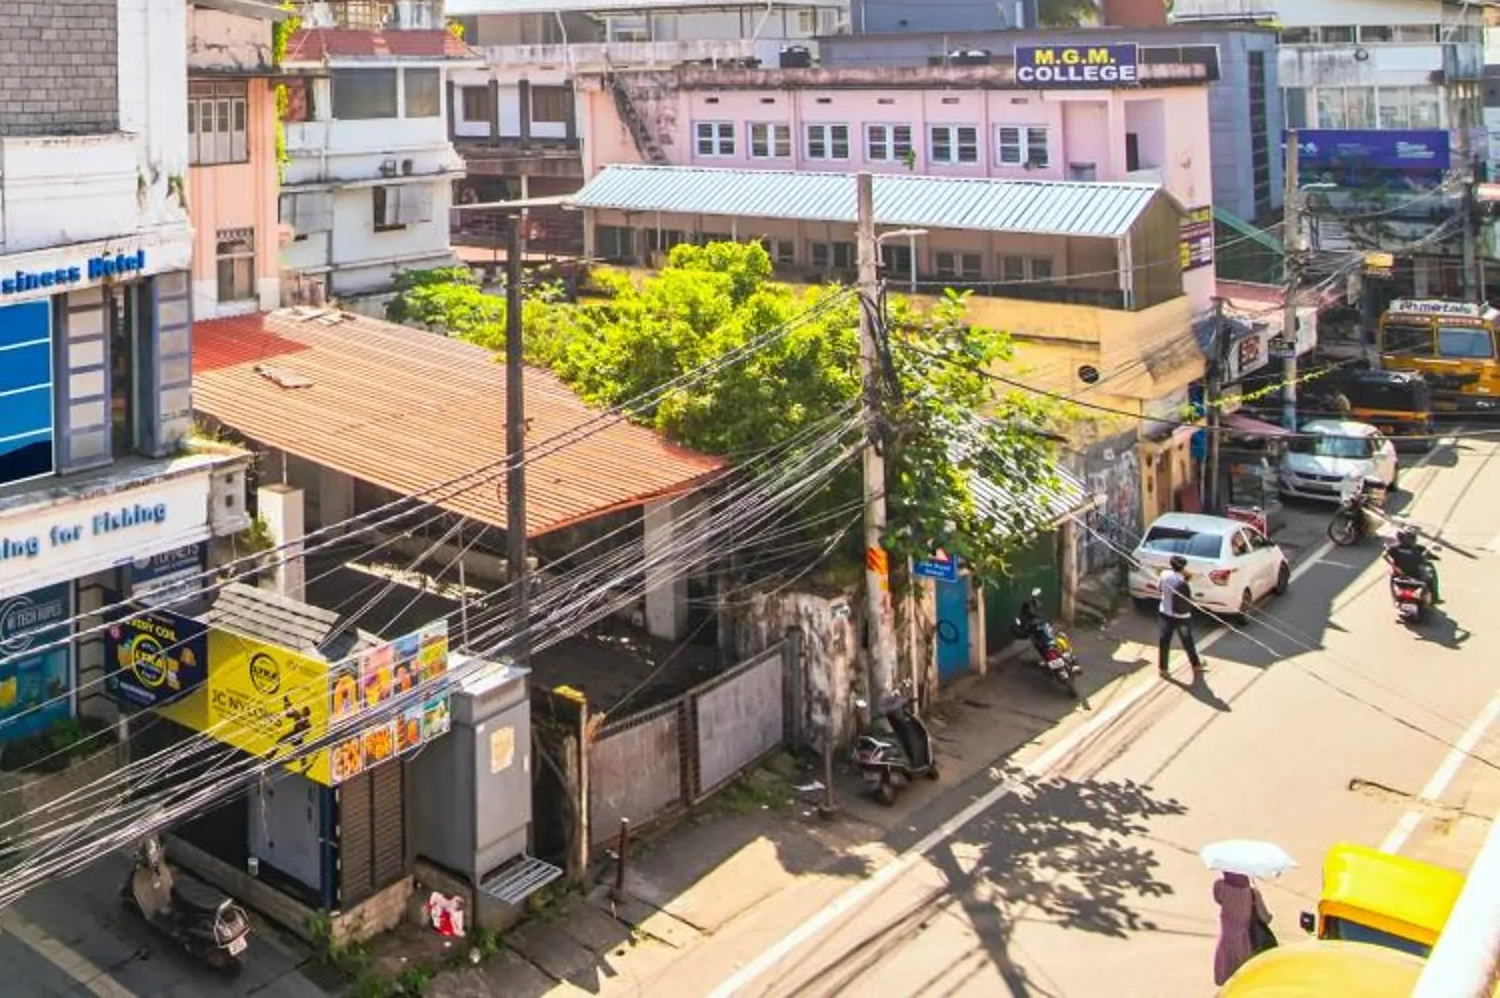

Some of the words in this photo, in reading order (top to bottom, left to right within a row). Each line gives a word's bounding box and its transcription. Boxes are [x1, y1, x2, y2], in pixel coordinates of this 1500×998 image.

[1033, 48, 1116, 65] M.G.M.
[1017, 65, 1136, 82] COLLEGE
[88, 248, 146, 281] Hotel
[49, 522, 84, 547] for
[93, 503, 166, 533] Fishing
